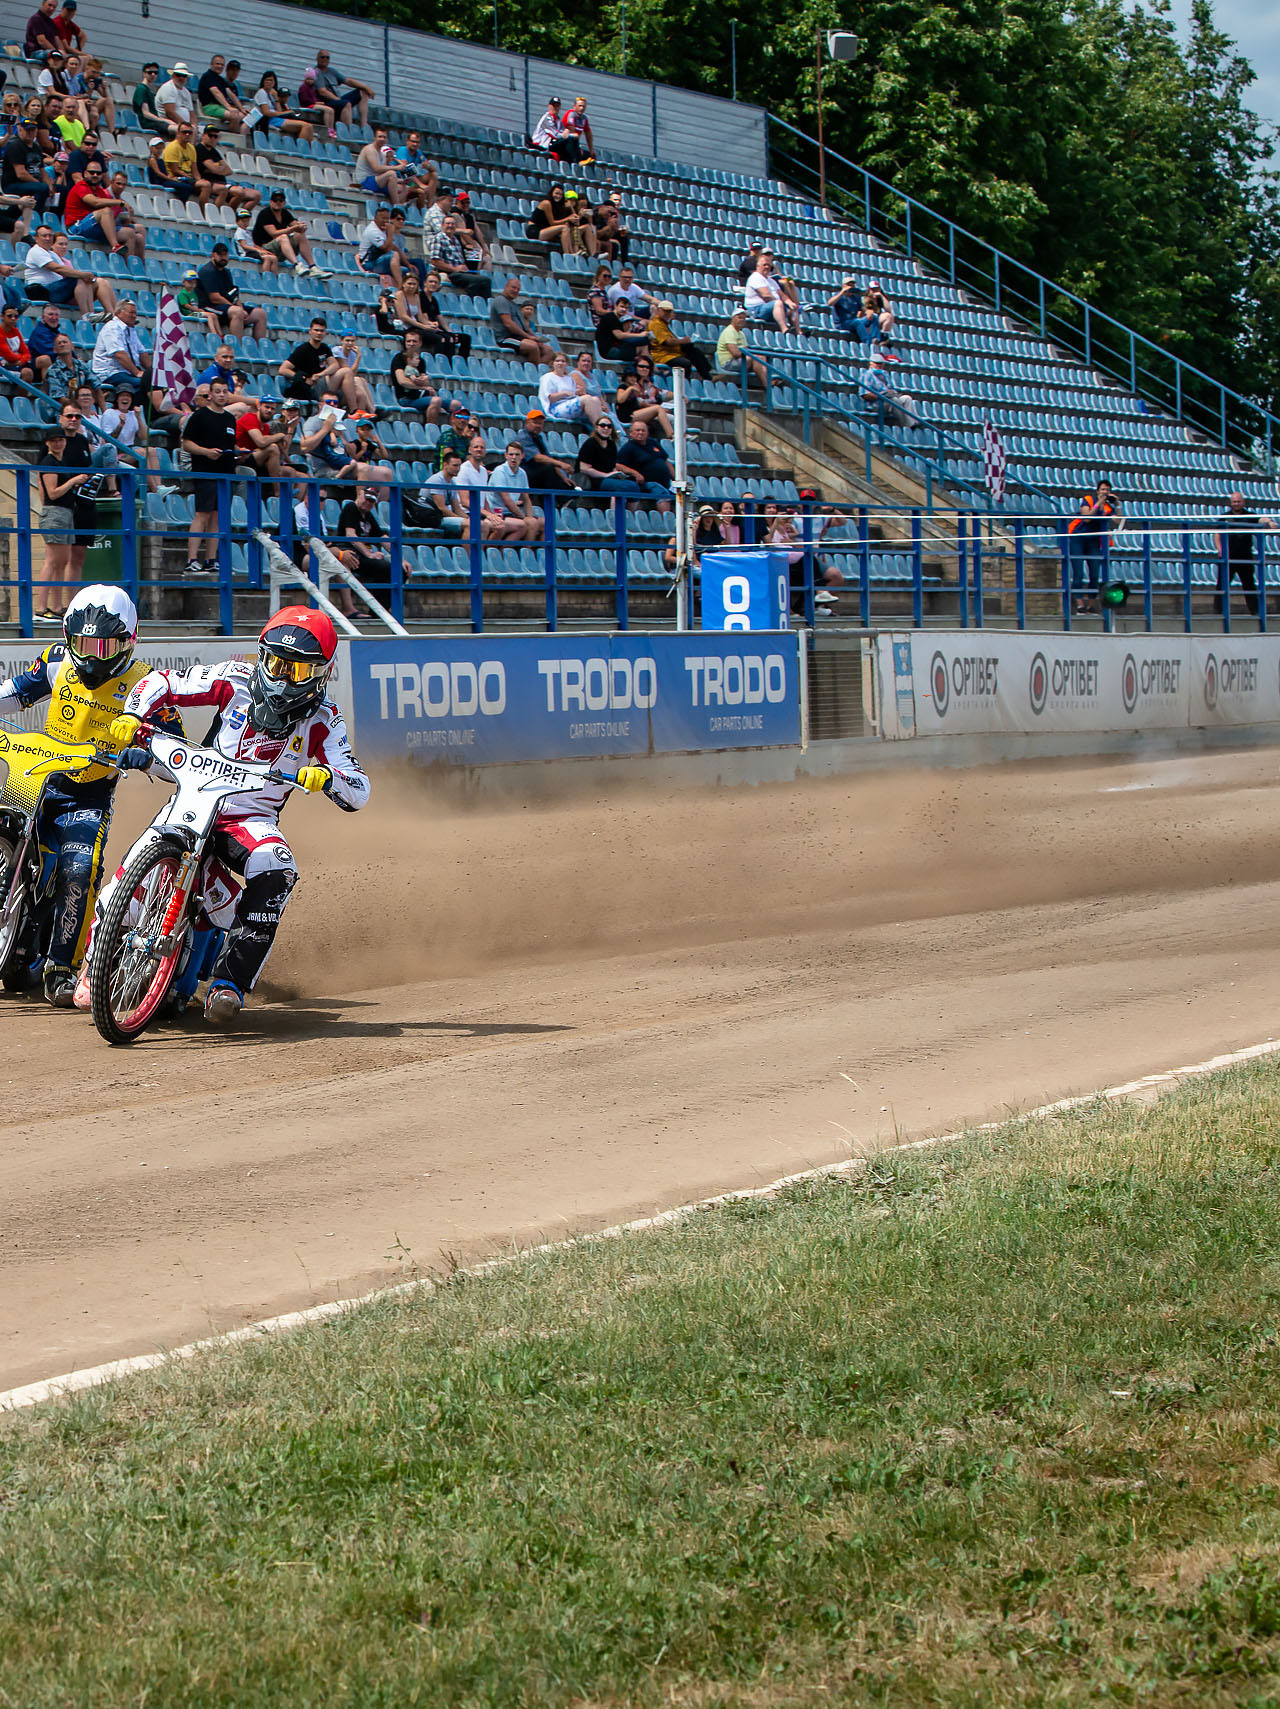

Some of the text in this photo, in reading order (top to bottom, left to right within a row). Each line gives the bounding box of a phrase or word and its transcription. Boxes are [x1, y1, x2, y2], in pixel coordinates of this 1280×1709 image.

[370, 660, 507, 720] TRODO
[537, 657, 657, 712] TRODO
[685, 654, 786, 706] TRODO
[952, 657, 999, 696] OPTIBET
[1052, 658, 1099, 697] OPTIBET
[1141, 659, 1182, 695] OPTIBET
[1221, 658, 1258, 692] OPTIBET
[73, 694, 123, 716] spechouse
[11, 742, 73, 763] spechouse
[191, 754, 250, 783] OPTIBET
